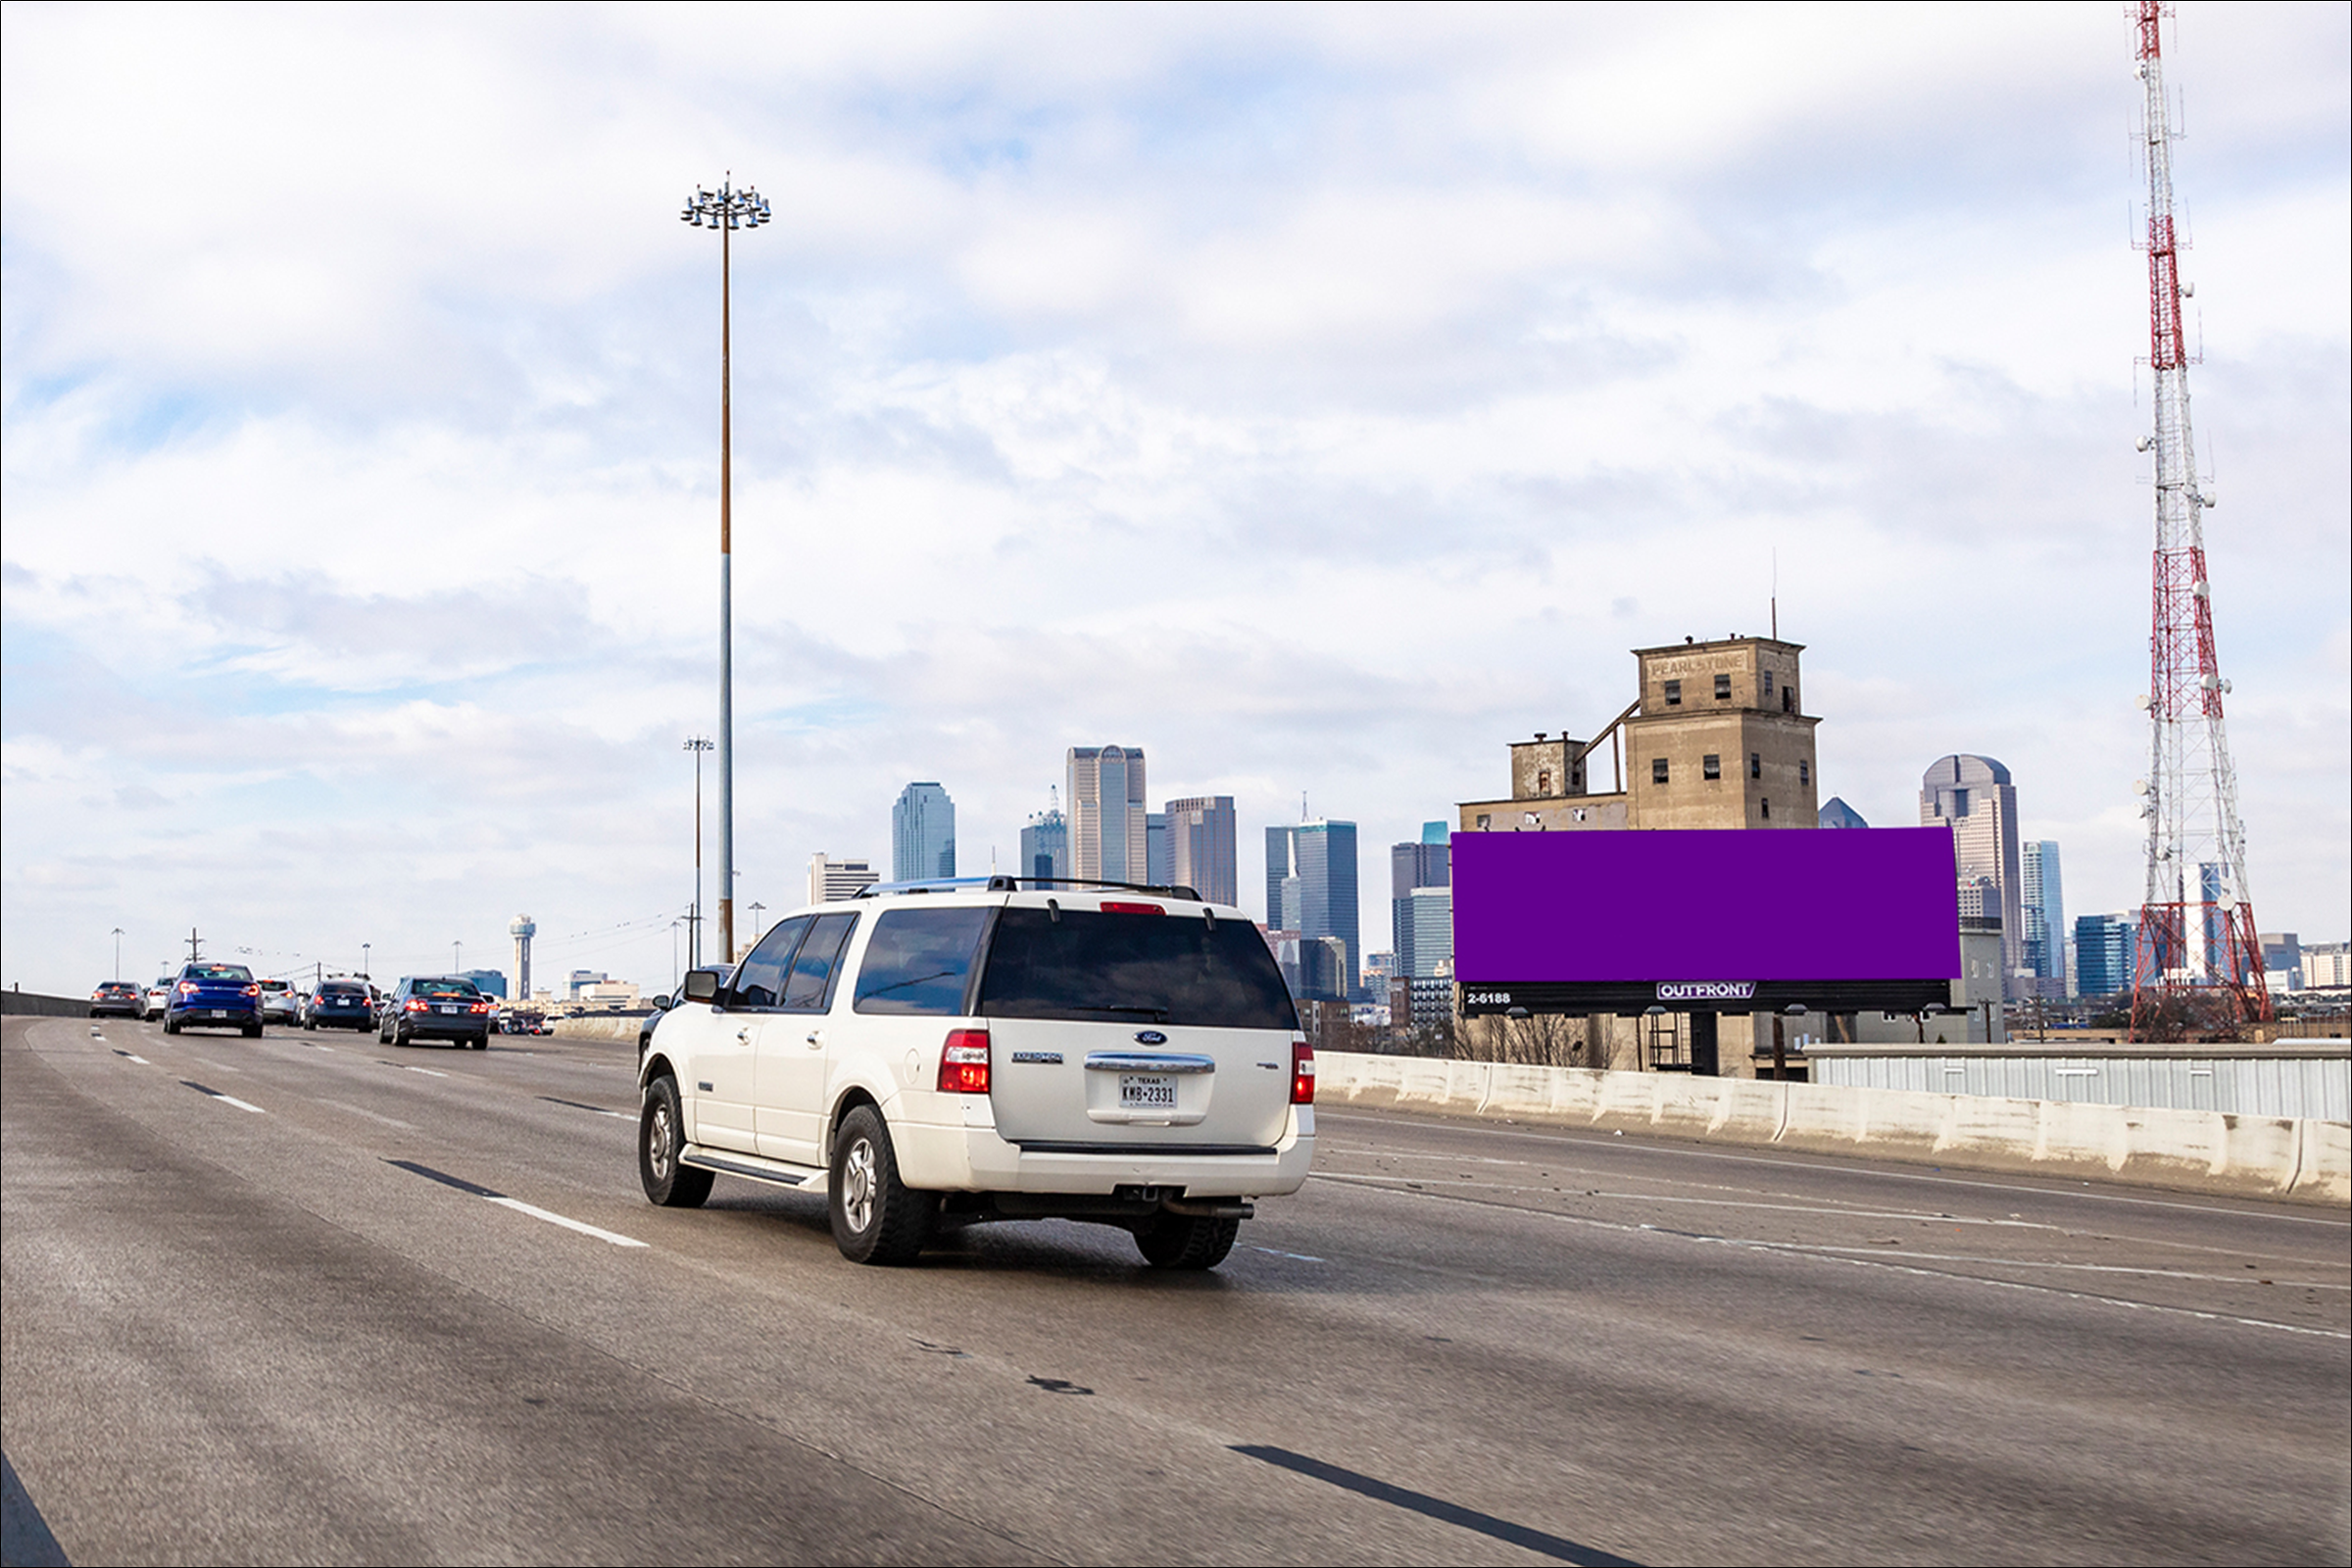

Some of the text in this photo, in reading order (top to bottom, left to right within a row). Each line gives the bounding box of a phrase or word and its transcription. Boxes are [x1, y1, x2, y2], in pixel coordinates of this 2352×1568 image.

[1651, 656, 1741, 676] PEARLSTONE
[1661, 983, 1750, 997] OUTFRONT
[1468, 993, 1511, 1004] 2-6188
